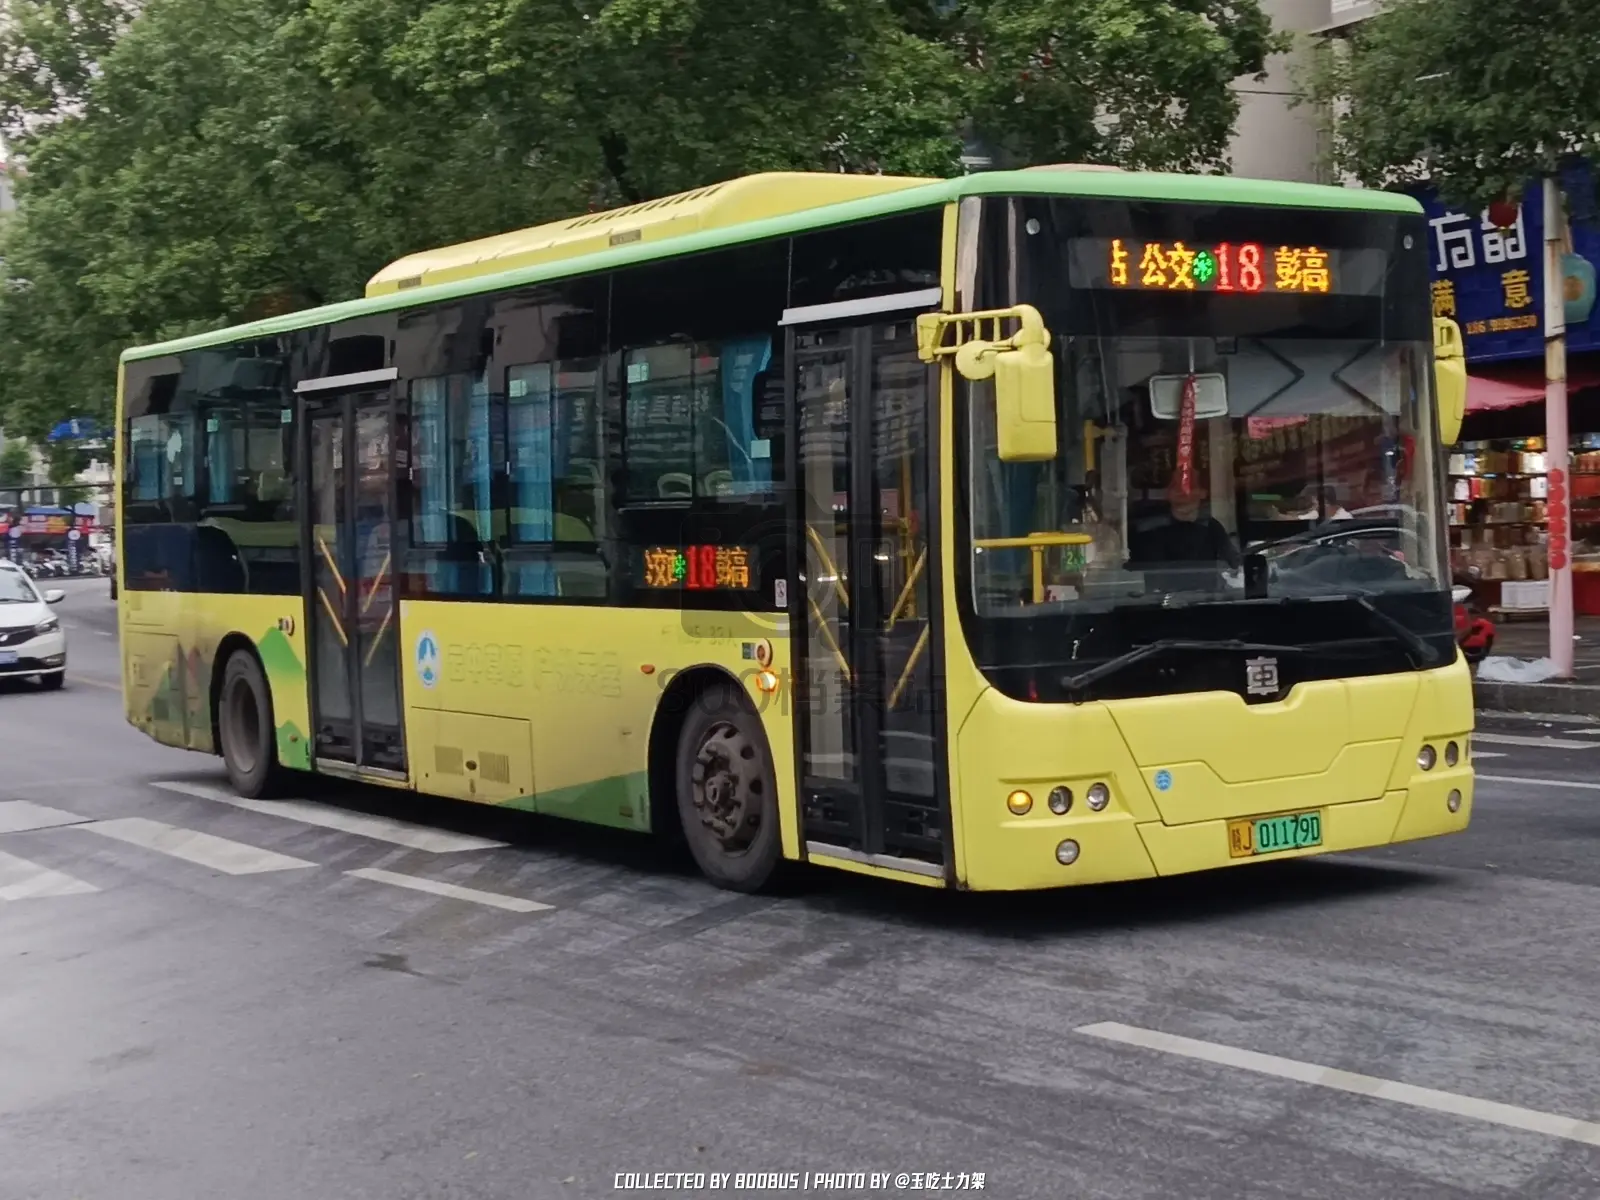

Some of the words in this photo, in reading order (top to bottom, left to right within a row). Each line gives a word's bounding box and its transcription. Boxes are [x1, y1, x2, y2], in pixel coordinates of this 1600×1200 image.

[1139, 241, 1195, 290] 公交
[1214, 241, 1263, 291] 18
[686, 545, 715, 588] 18
